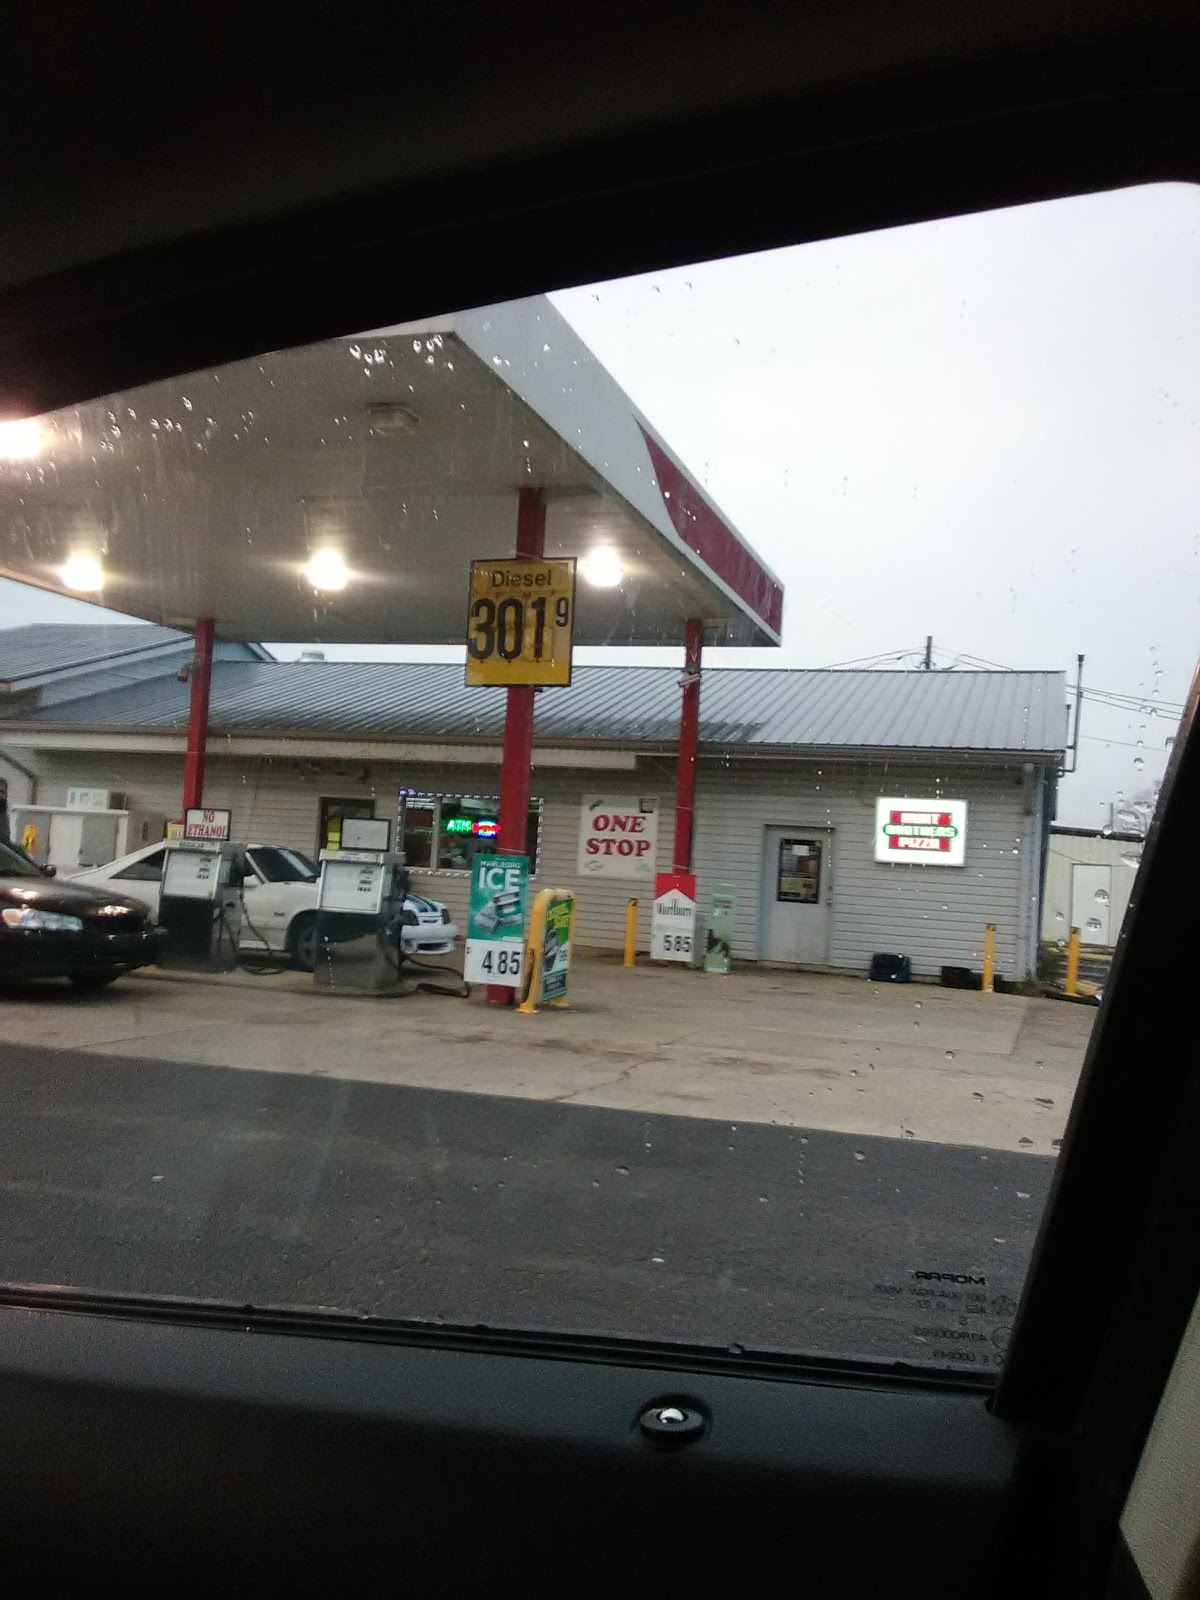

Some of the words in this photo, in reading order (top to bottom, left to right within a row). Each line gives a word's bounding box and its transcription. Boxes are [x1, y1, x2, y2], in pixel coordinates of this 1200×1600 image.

[491, 569, 552, 588] Diesel
[202, 810, 215, 824] NO
[446, 819, 472, 832] ATM
[592, 814, 646, 833] ONE
[187, 824, 227, 837] ETHANOL
[585, 837, 650, 857] STOP
[478, 867, 521, 892] ICE
[663, 934, 692, 953] 585
[482, 950, 521, 975] 485
